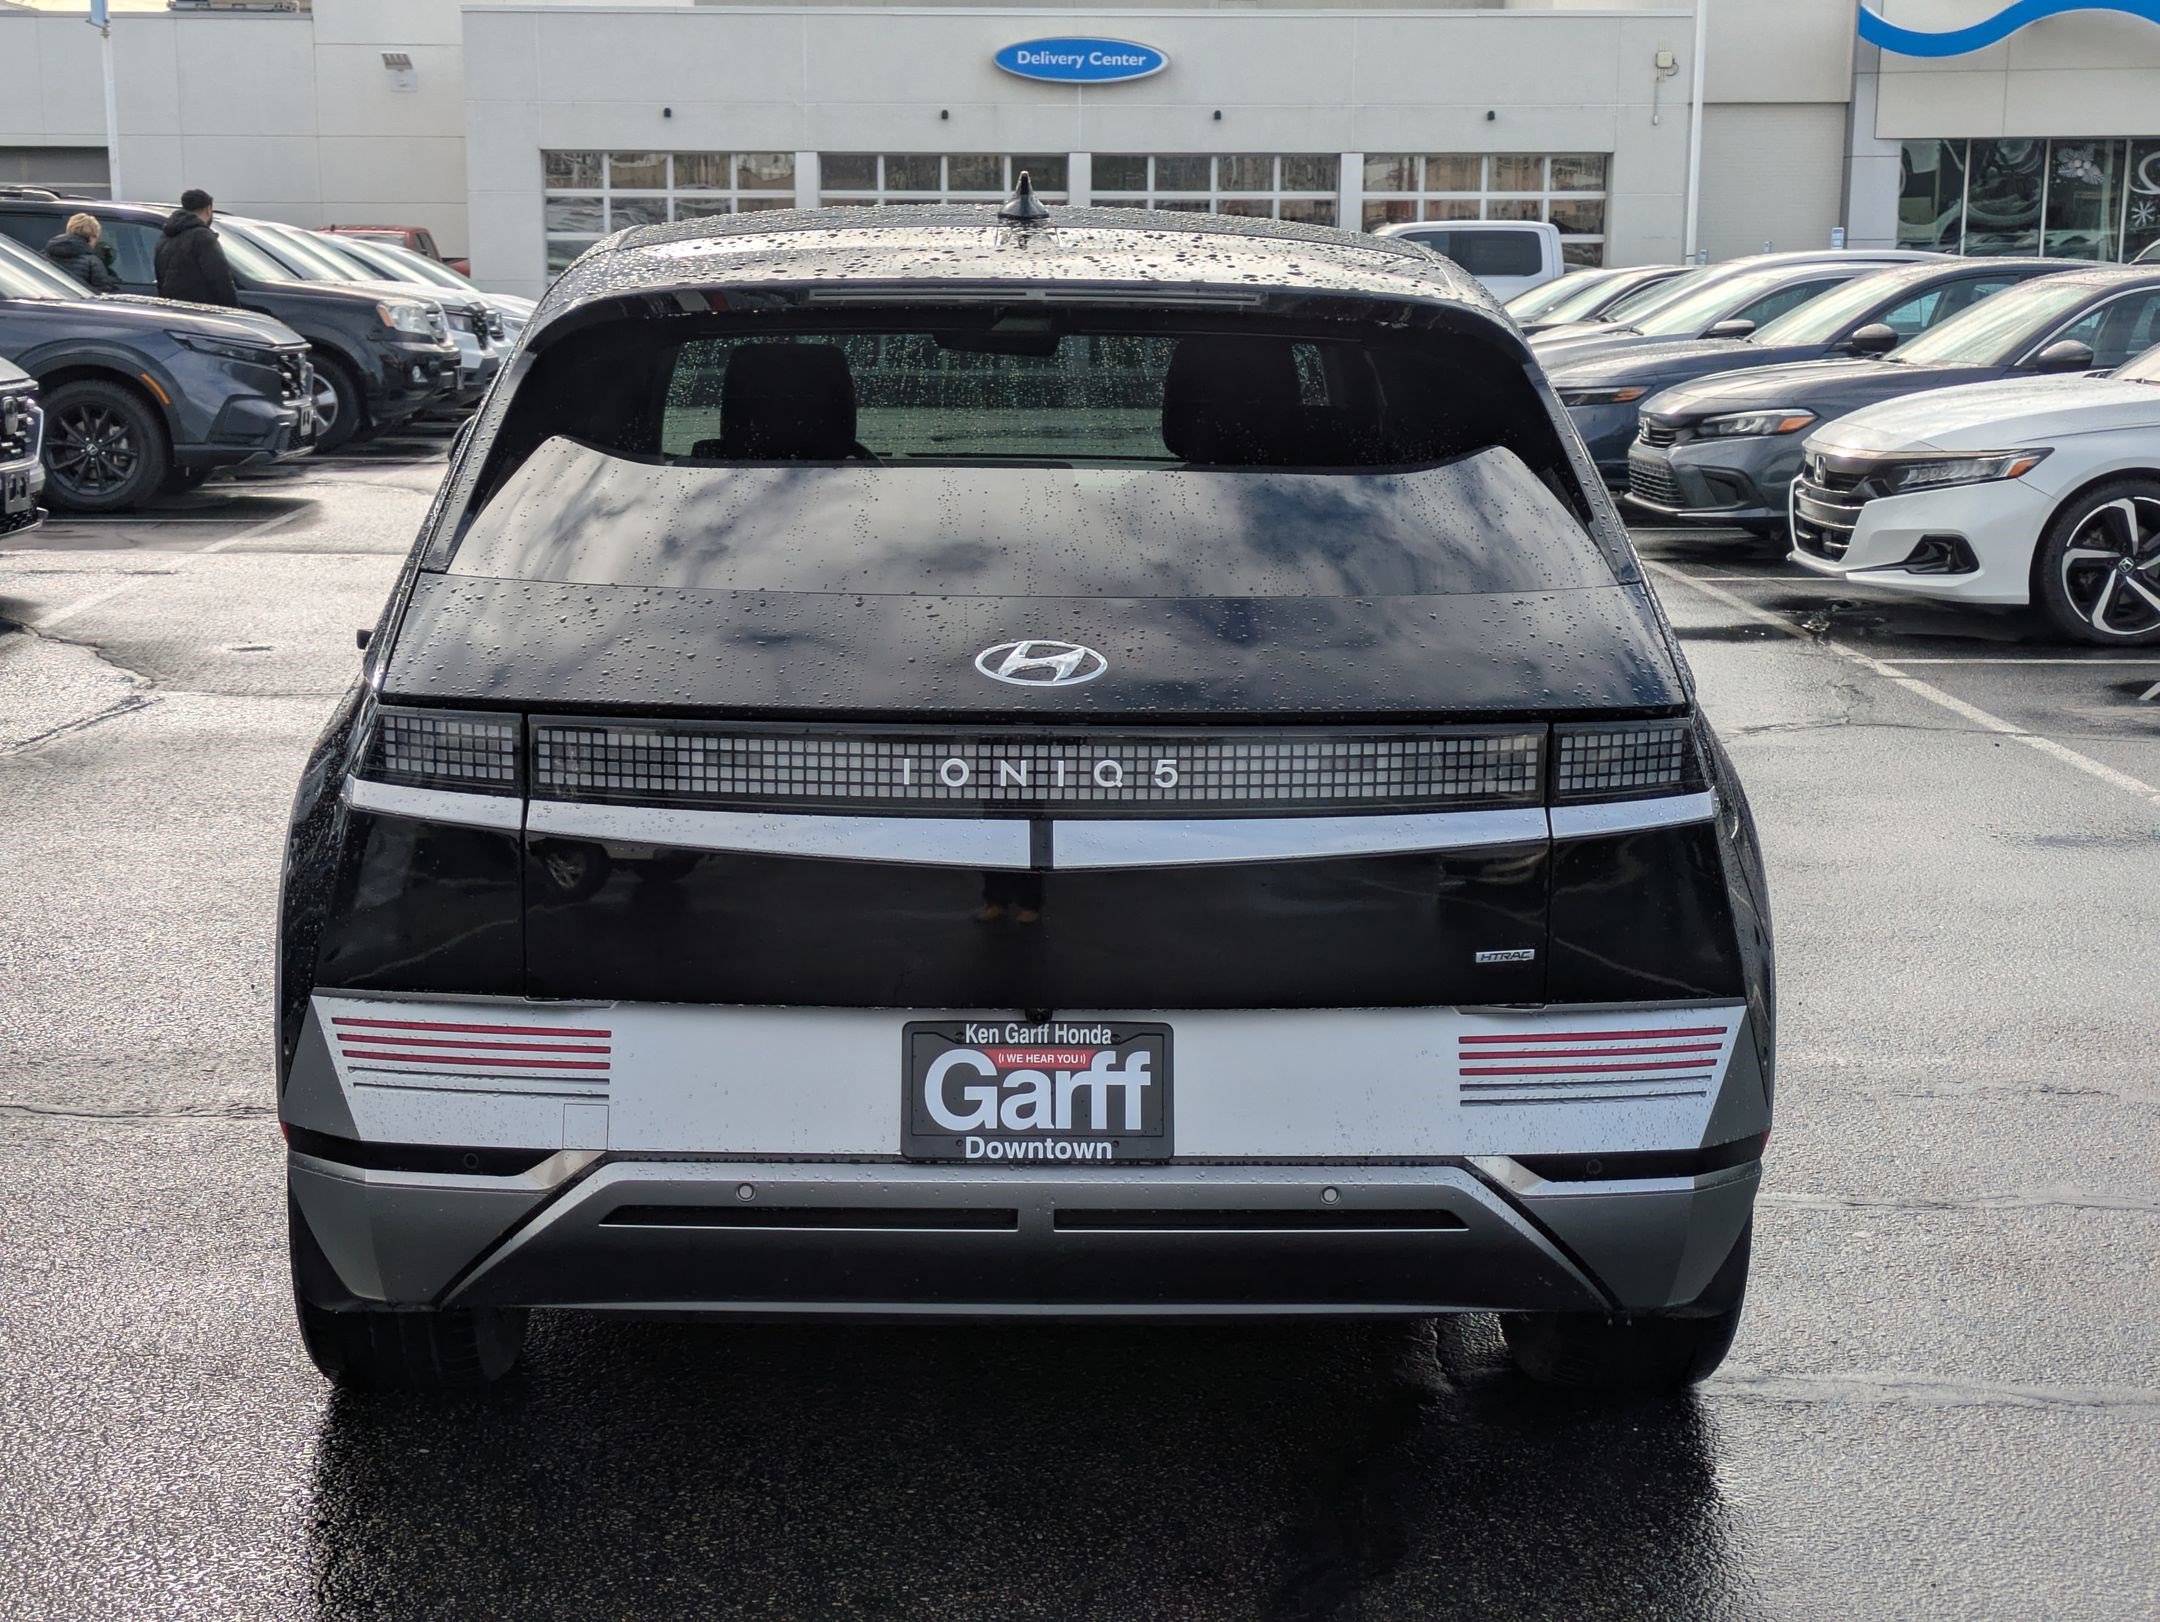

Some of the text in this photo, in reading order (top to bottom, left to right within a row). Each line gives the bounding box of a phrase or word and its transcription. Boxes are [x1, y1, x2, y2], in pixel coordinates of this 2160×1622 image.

[1017, 51, 1147, 69] Delivery Center
[1480, 950, 1532, 961] HTRAC
[965, 1023, 1112, 1045] Ken Garff Honda
[1006, 1054, 1079, 1064] WE HEAR YOU
[924, 1048, 1151, 1131] Garff
[965, 1136, 1112, 1159] Downtown
